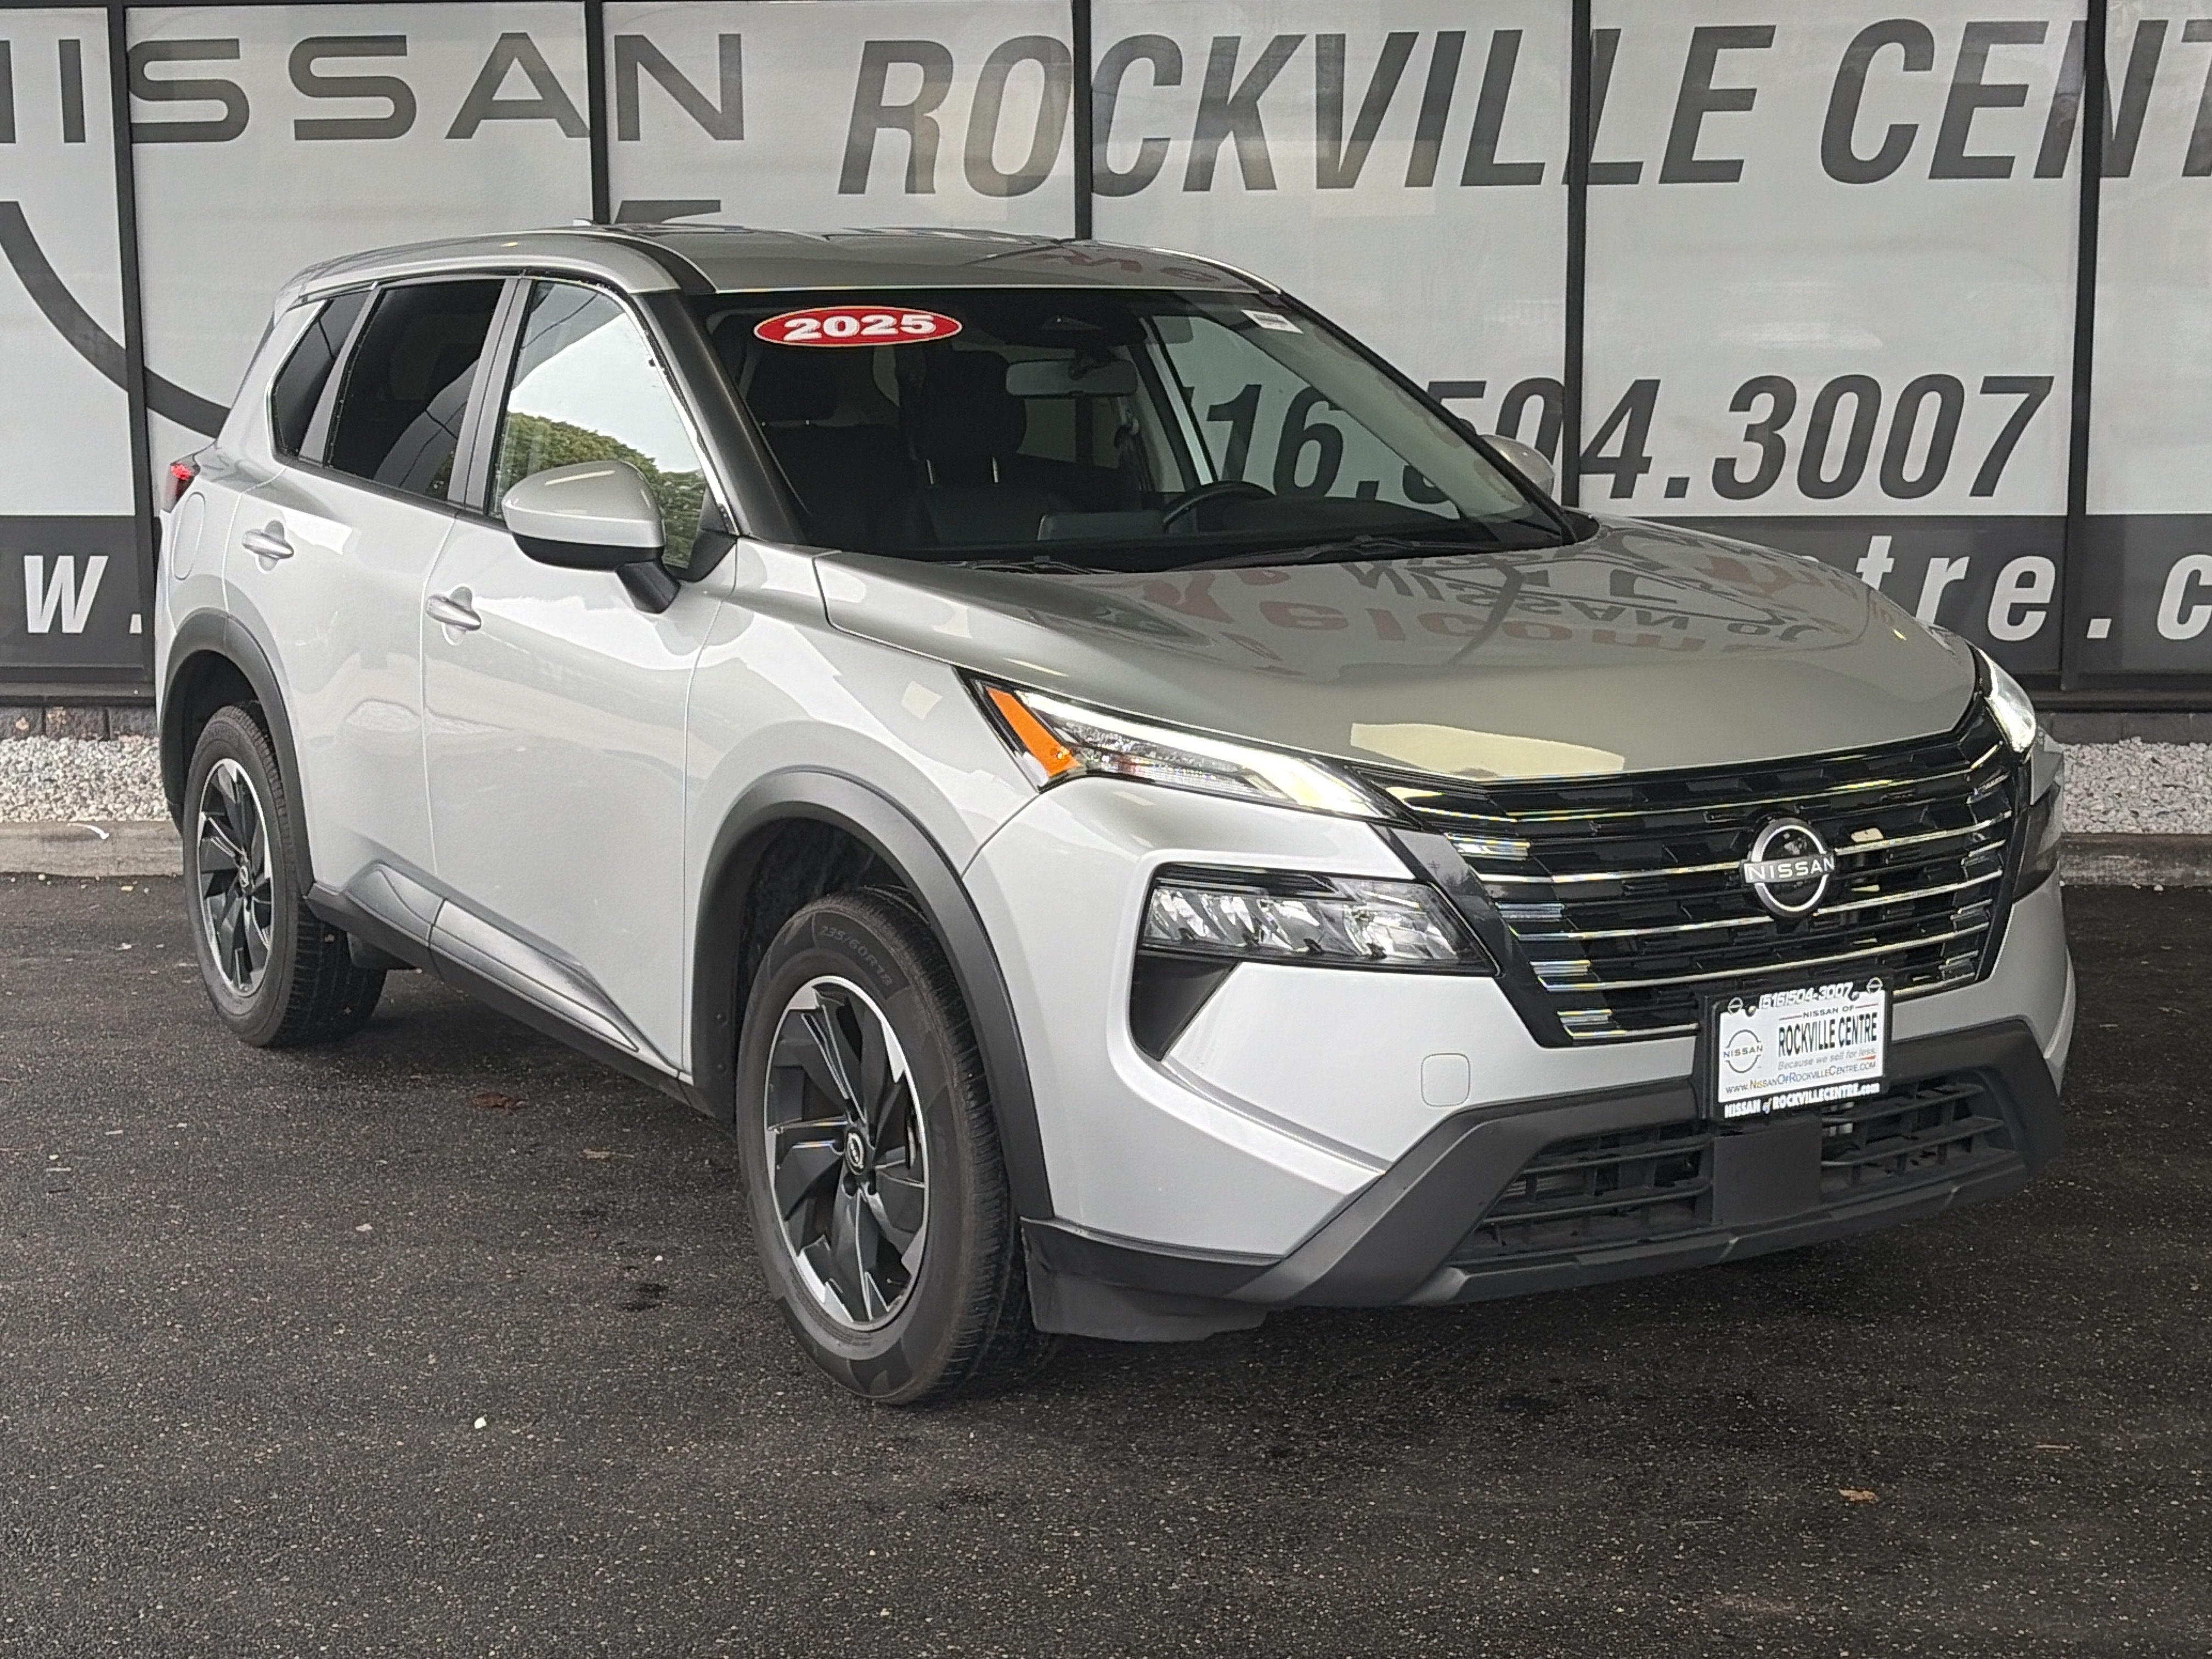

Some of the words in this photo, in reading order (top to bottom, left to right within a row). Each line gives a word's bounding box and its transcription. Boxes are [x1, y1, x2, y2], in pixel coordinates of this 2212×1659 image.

[838, 29, 1776, 196] ROCKVILLE
[783, 314, 936, 342] 2025
[1748, 856, 1835, 880] NISSAN
[1803, 1007, 1839, 1018] NISSAN
[1779, 1019, 1836, 1058] ROCKVILLE
[1838, 1012, 1878, 1047] CENTRE
[1723, 1045, 1764, 1058] NISSAN
[1724, 1098, 1761, 1119] NISSAN
